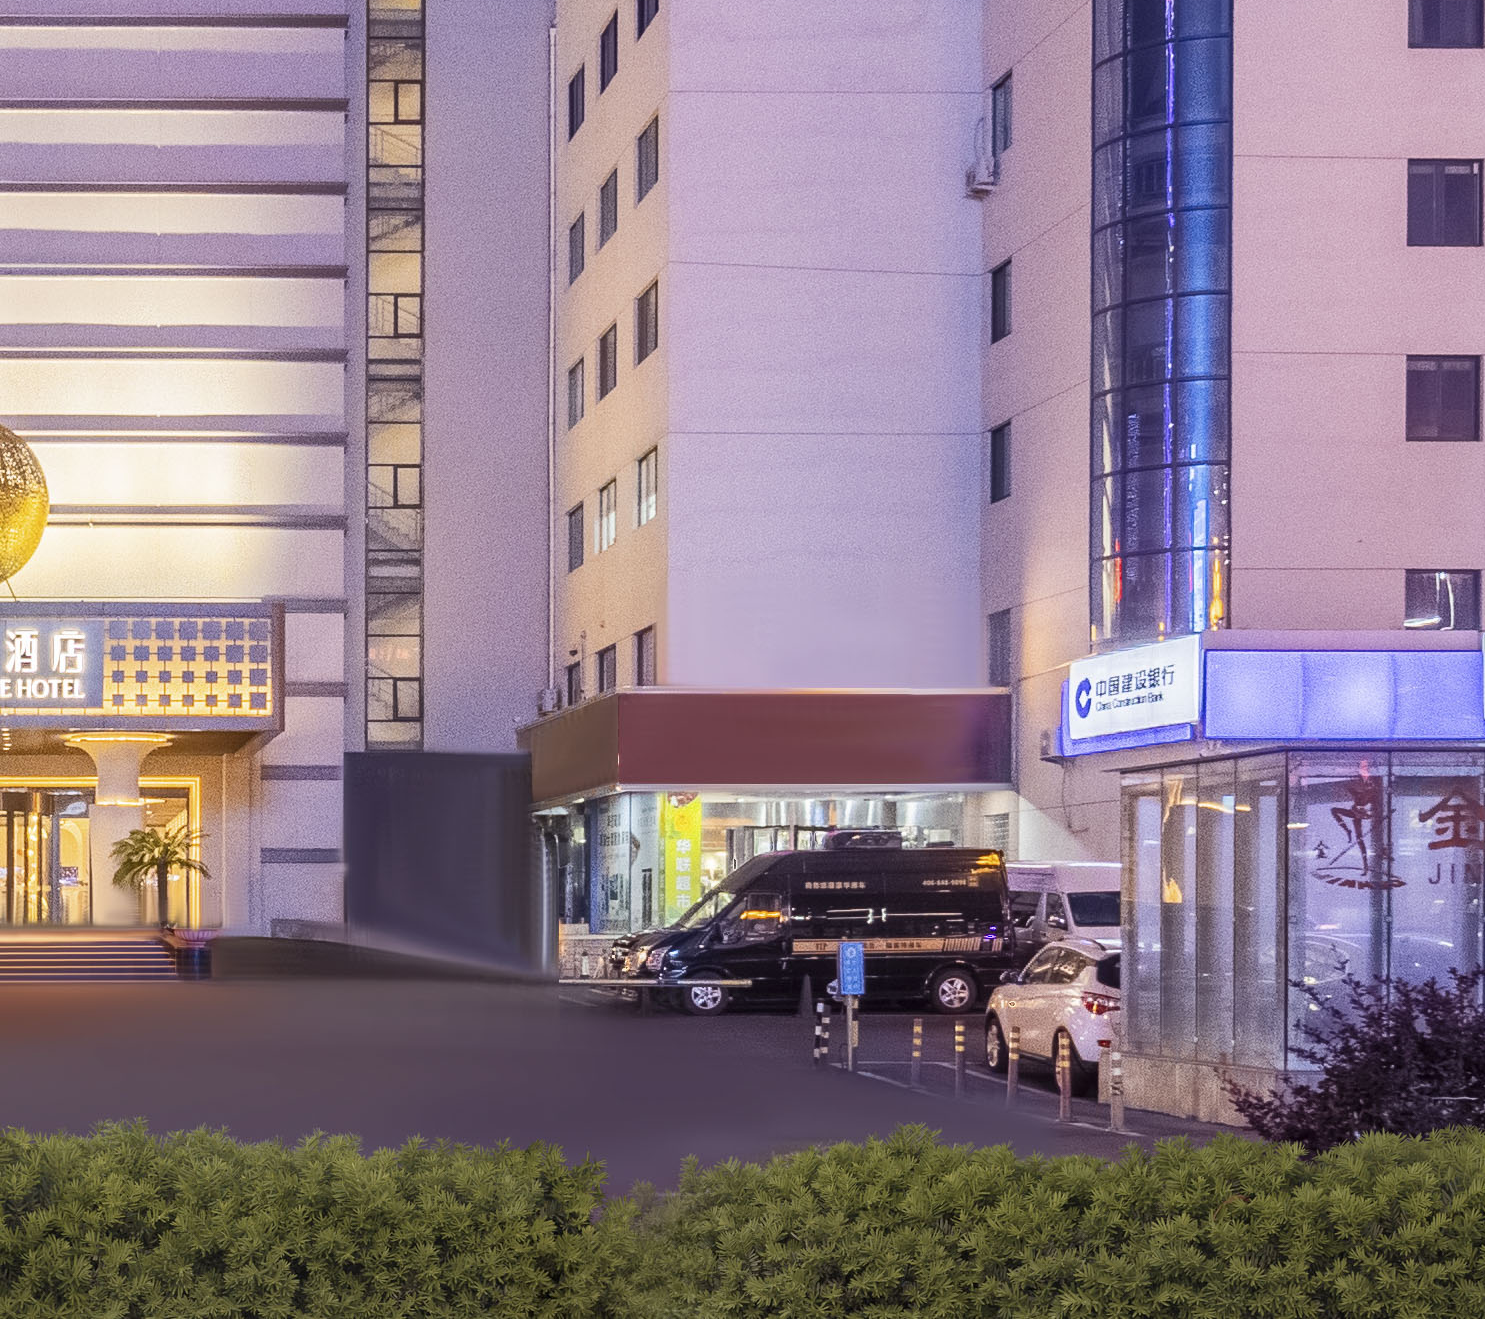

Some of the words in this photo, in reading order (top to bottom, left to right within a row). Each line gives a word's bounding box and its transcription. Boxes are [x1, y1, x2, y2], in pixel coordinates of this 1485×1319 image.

[17, 678, 86, 699] HOTEL
[1096, 664, 1175, 697] 中国建设银行
